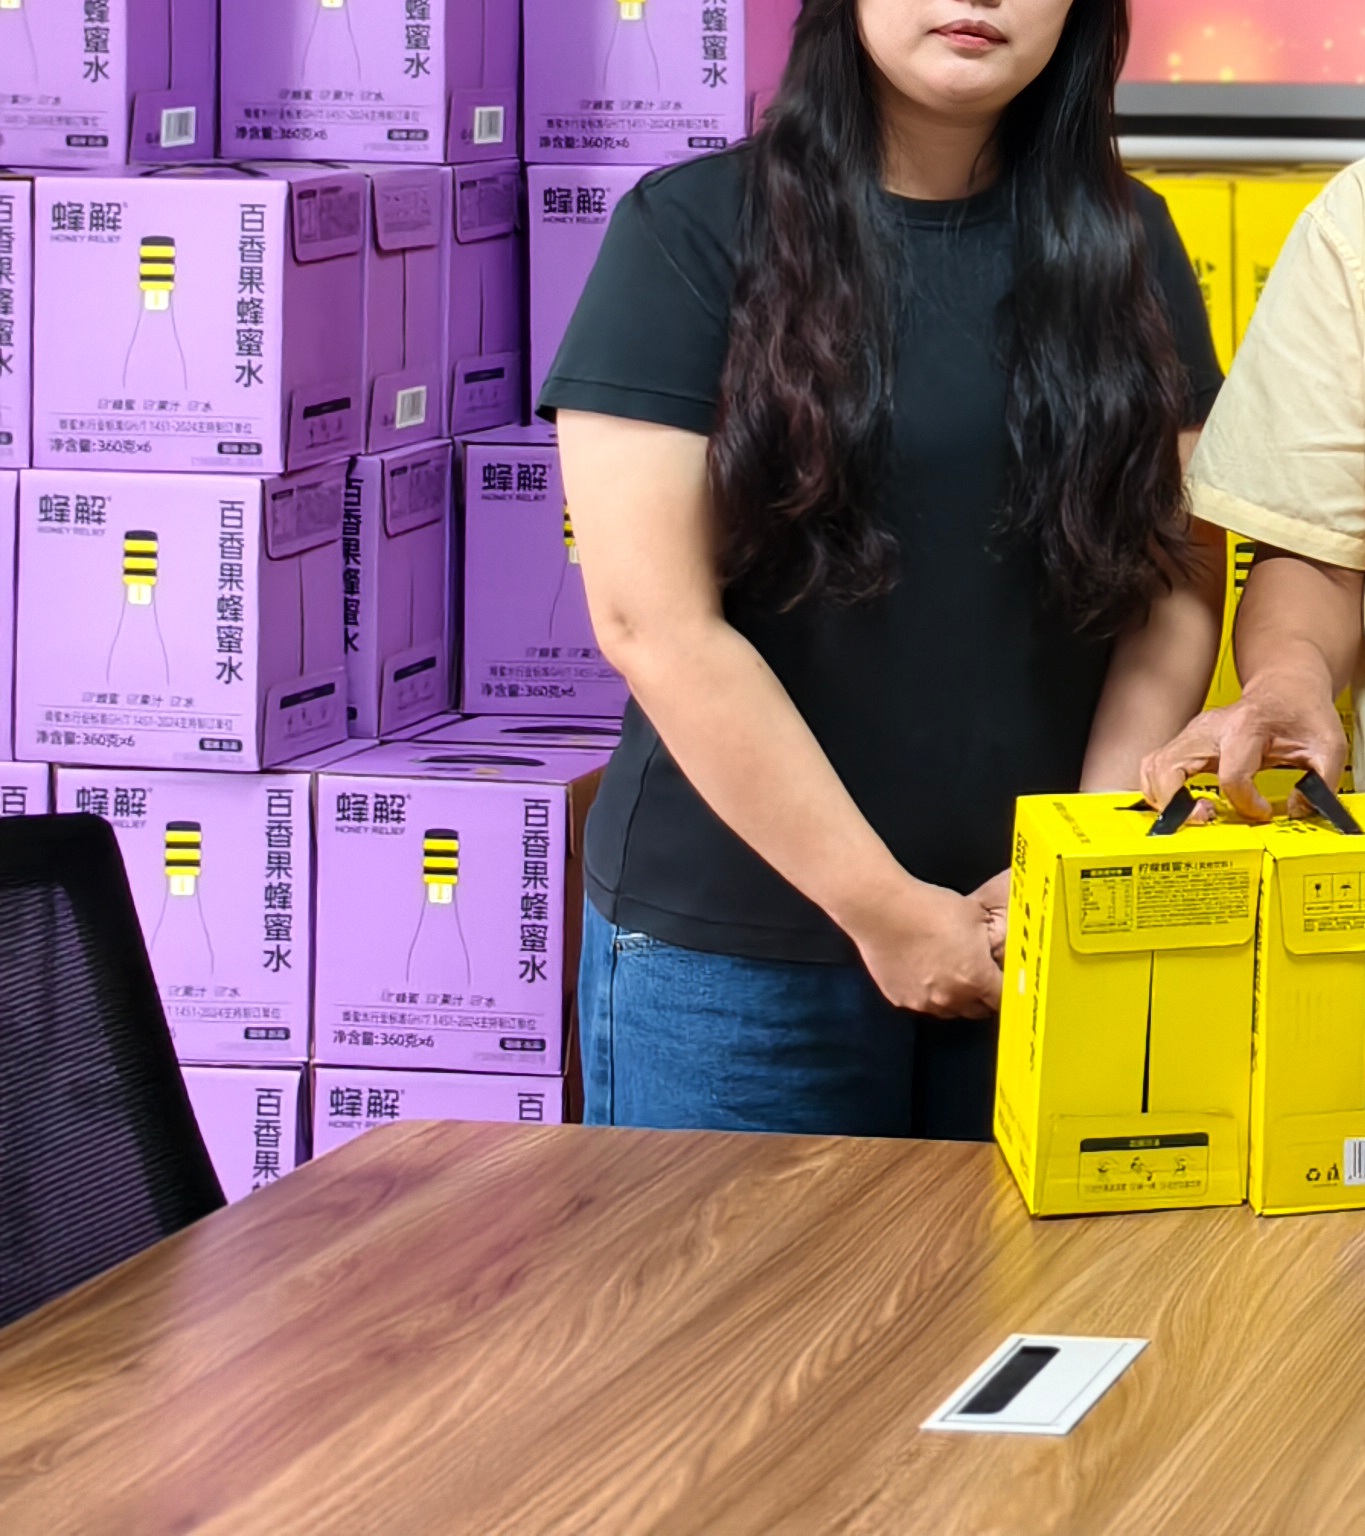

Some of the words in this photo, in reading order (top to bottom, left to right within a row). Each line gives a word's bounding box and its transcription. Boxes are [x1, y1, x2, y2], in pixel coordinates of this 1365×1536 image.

[51, 201, 123, 232] 蜂解
[543, 187, 608, 215] 蜂解
[235, 203, 267, 388] 百香果蜂蜜水
[482, 463, 548, 491] 蜂解
[38, 494, 107, 525] 蜂解
[216, 500, 245, 685] 百香果蜂蜜水
[1, 786, 27, 814] 百
[76, 787, 146, 817] 蜂解
[336, 792, 406, 824] 蜂解
[263, 788, 293, 972] 百香果蜂蜜水
[519, 798, 551, 984] 百香果蜂蜜水
[329, 1087, 400, 1120] 蜂解
[517, 1092, 546, 1121] 百
[252, 1088, 283, 1192] 百香果
